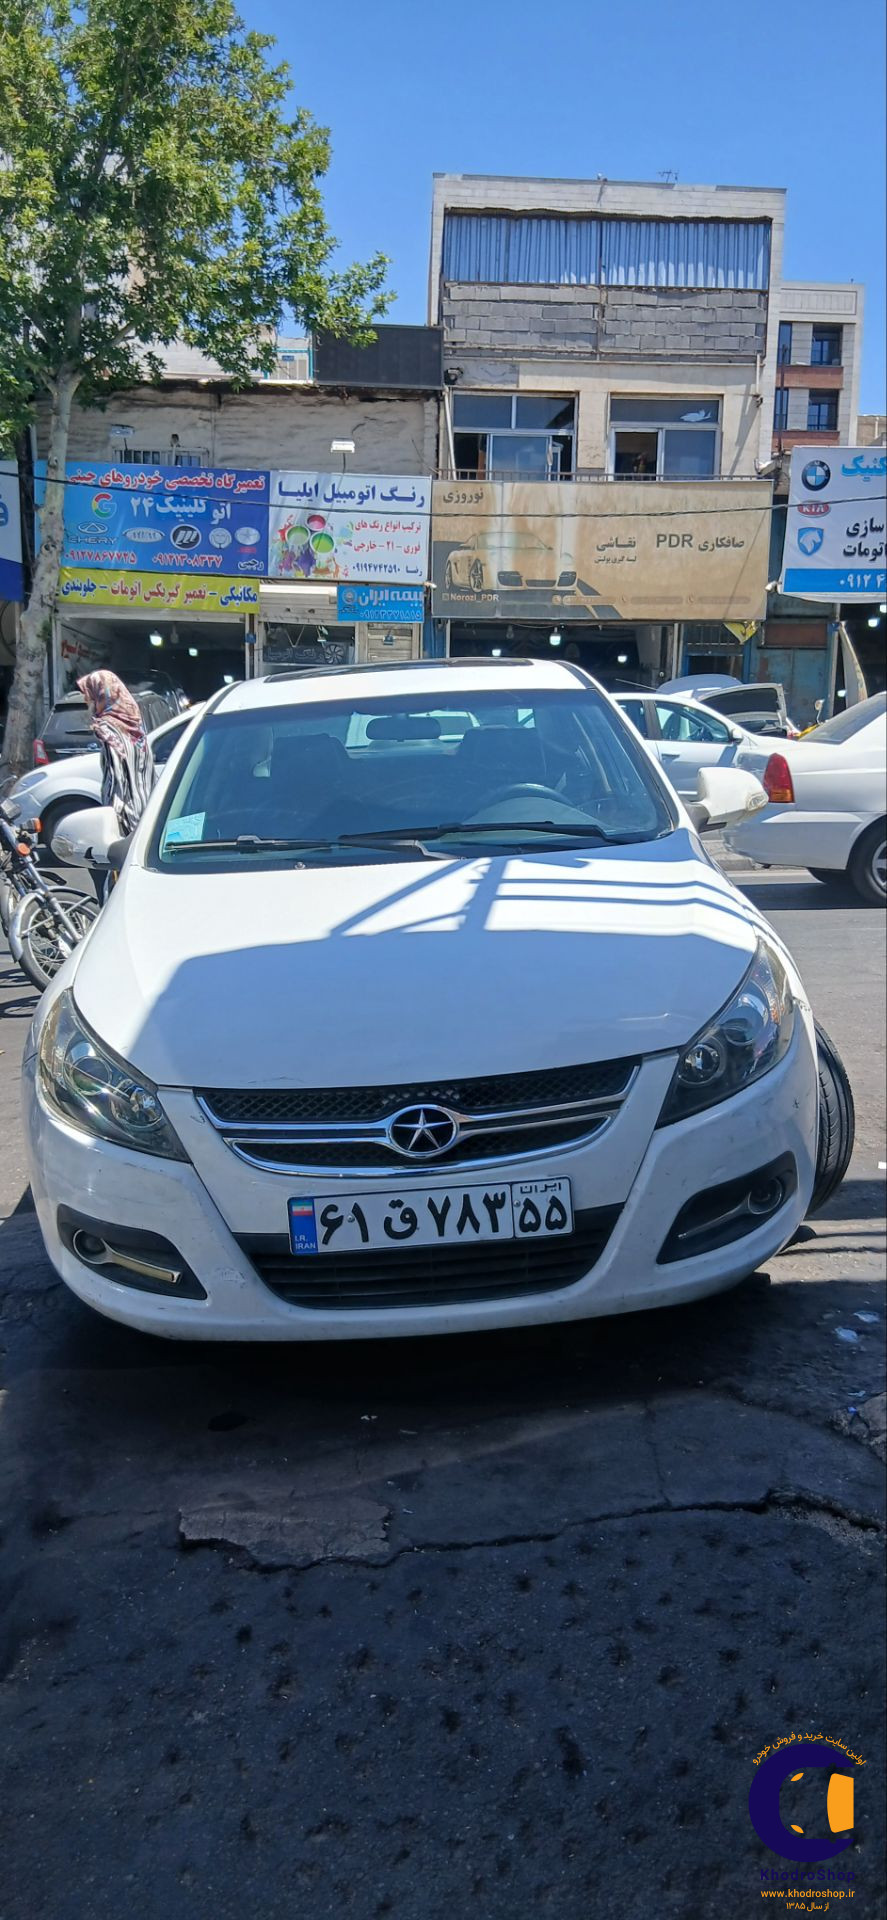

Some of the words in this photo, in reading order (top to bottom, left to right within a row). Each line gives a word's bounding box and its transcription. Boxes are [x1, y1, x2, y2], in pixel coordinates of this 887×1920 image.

[99, 469, 162, 489] خودروهای
[165, 472, 214, 491] تخصصی
[216, 474, 265, 493] تعمیرگاه
[278, 481, 319, 502] ایلیا
[323, 484, 375, 505] اتومبیل
[380, 485, 425, 508] رنگ
[443, 489, 484, 505] نوروزی
[130, 497, 154, 518] ۲۴
[211, 503, 231, 524] اتو
[355, 520, 368, 531] های
[369, 520, 383, 531] رنگ
[385, 520, 401, 532] انواع
[402, 521, 422, 534] ترکیب
[846, 517, 885, 538] سازی
[354, 540, 377, 552] خارجی
[403, 542, 421, 554] فوری
[596, 536, 637, 552] نقاشی
[656, 533, 693, 549] PDR
[698, 535, 745, 552] صافکاری
[405, 565, 423, 577] رضا
[61, 578, 97, 598] جلوبندی
[111, 579, 142, 601] اتومات
[840, 574, 872, 589] ۰۹۱۲
[143, 583, 181, 603] گیربکس
[184, 584, 206, 604] تعمیر
[220, 586, 258, 606] مکانیکی
[359, 588, 389, 606] ایران
[390, 591, 423, 607] بیمه
[520, 1182, 562, 1194] ایران
[320, 1201, 370, 1245] ۶۱
[384, 1199, 419, 1240] ق
[427, 1192, 506, 1237] ۷۸۳
[519, 1195, 568, 1233] ۵۵
[295, 1242, 317, 1250] IRAN
